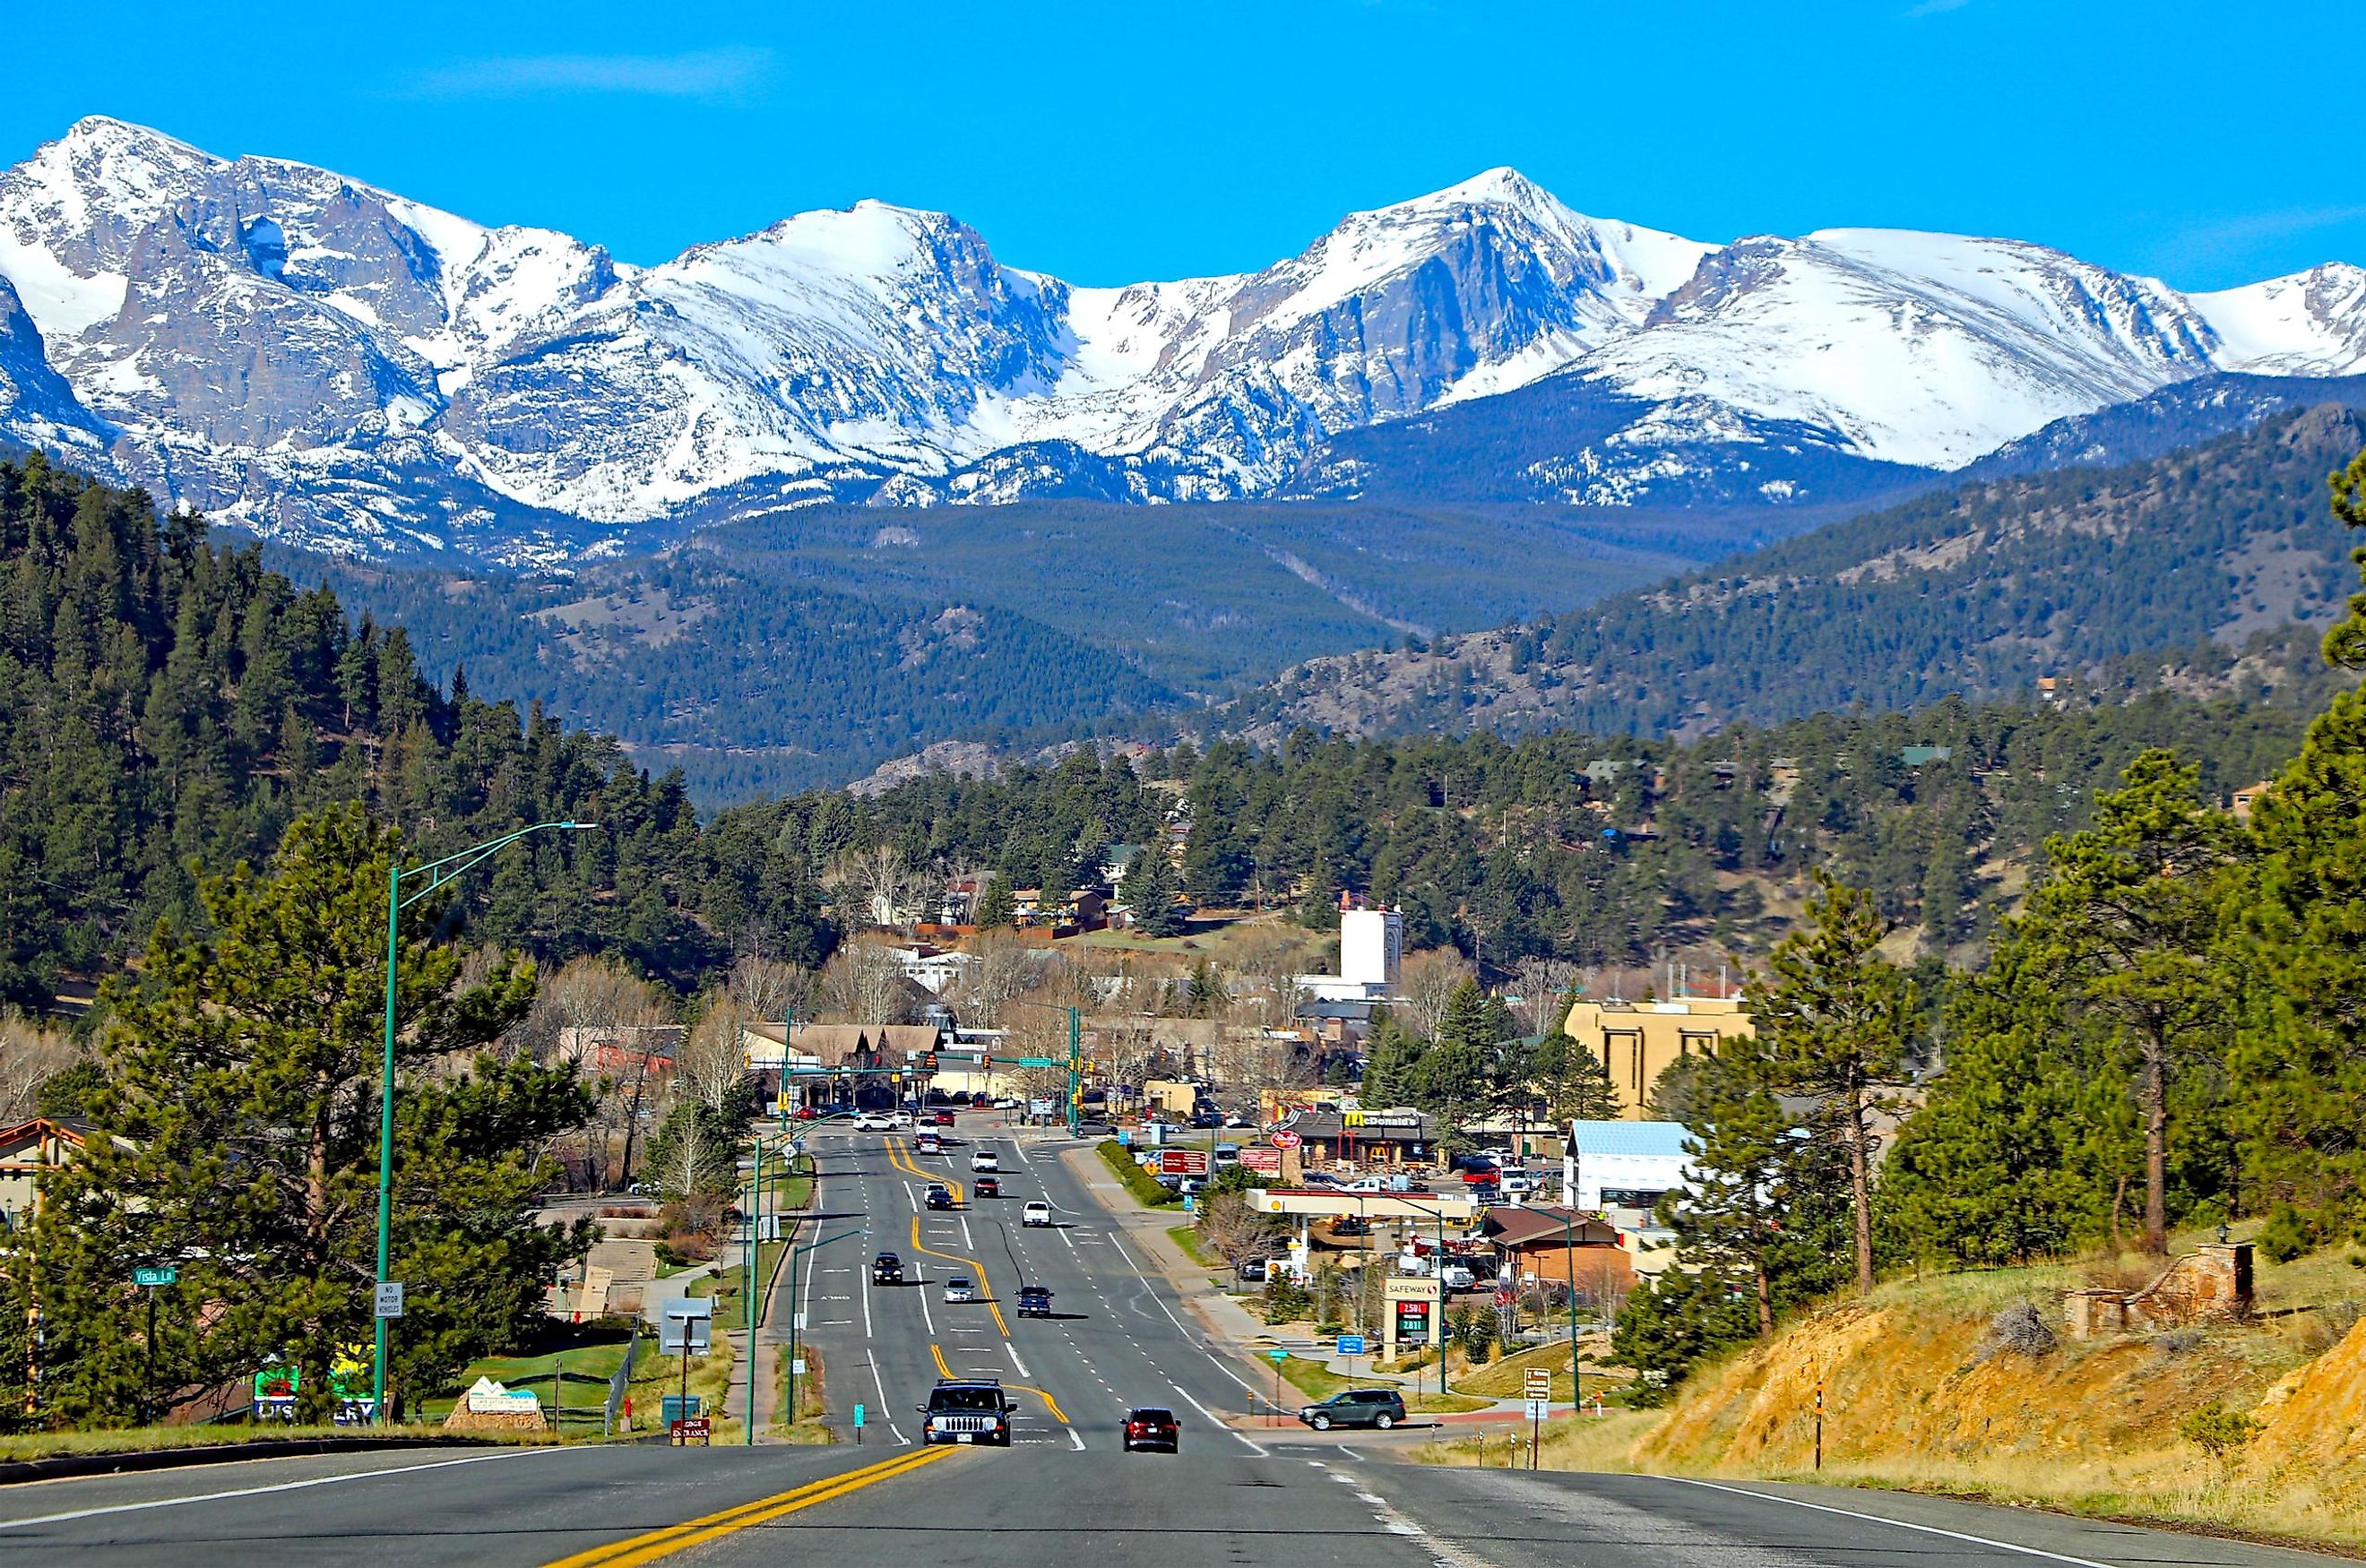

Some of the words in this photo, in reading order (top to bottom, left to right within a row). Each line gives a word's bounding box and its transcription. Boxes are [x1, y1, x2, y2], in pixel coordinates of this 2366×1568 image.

[1344, 1111, 1416, 1126] McDonald's
[136, 1271, 158, 1282] Vista
[161, 1270, 172, 1281] Ln
[385, 1286, 393, 1294] NO
[1389, 1285, 1426, 1293] SAFEWAY
